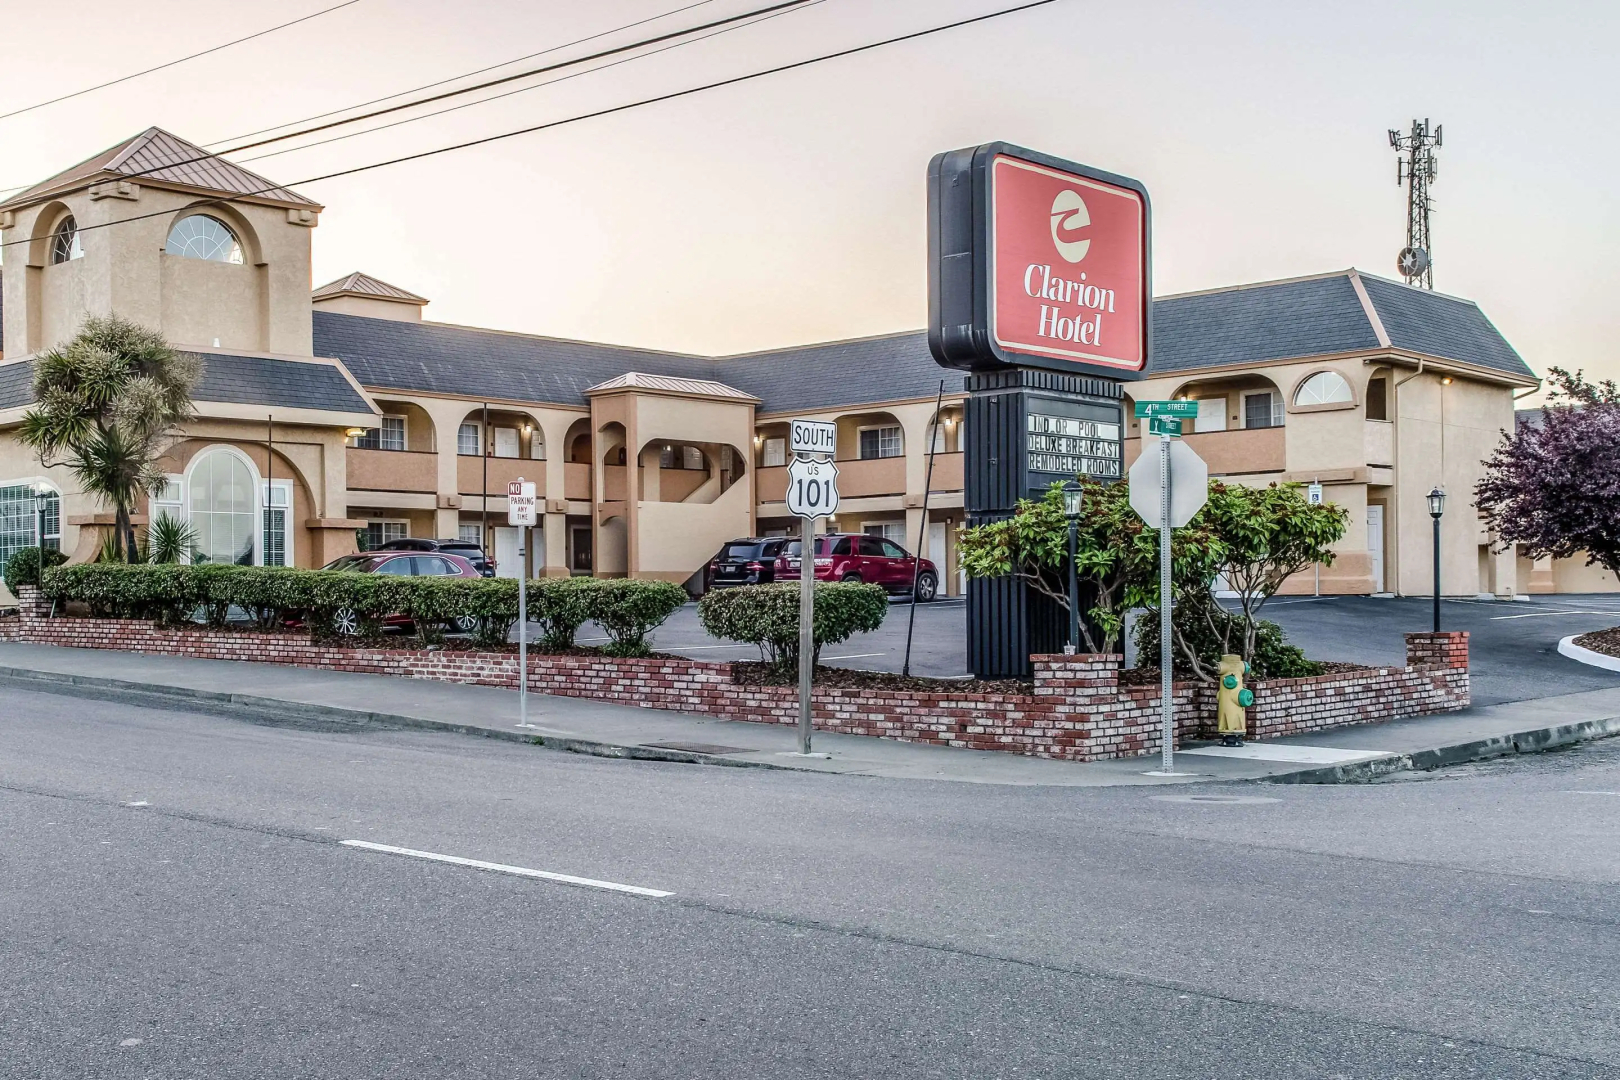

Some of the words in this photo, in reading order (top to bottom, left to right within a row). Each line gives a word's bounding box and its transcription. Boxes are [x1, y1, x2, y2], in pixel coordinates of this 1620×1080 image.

[1024, 264, 1115, 313] Clarion
[1036, 304, 1102, 347] Hotel
[1145, 404, 1159, 416] 4TH
[794, 425, 834, 446] SOUTH
[1033, 416, 1067, 434] INDOR
[1078, 421, 1101, 438] POOL
[1028, 435, 1063, 453] DELUXE
[1065, 438, 1118, 458] BREAKFAST
[807, 466, 819, 475] US
[1029, 454, 1082, 472] REMODELED
[1086, 459, 1117, 475] ROOMS
[510, 483, 520, 493] NO
[797, 478, 830, 508] 101
[510, 497, 534, 505] PARKING
